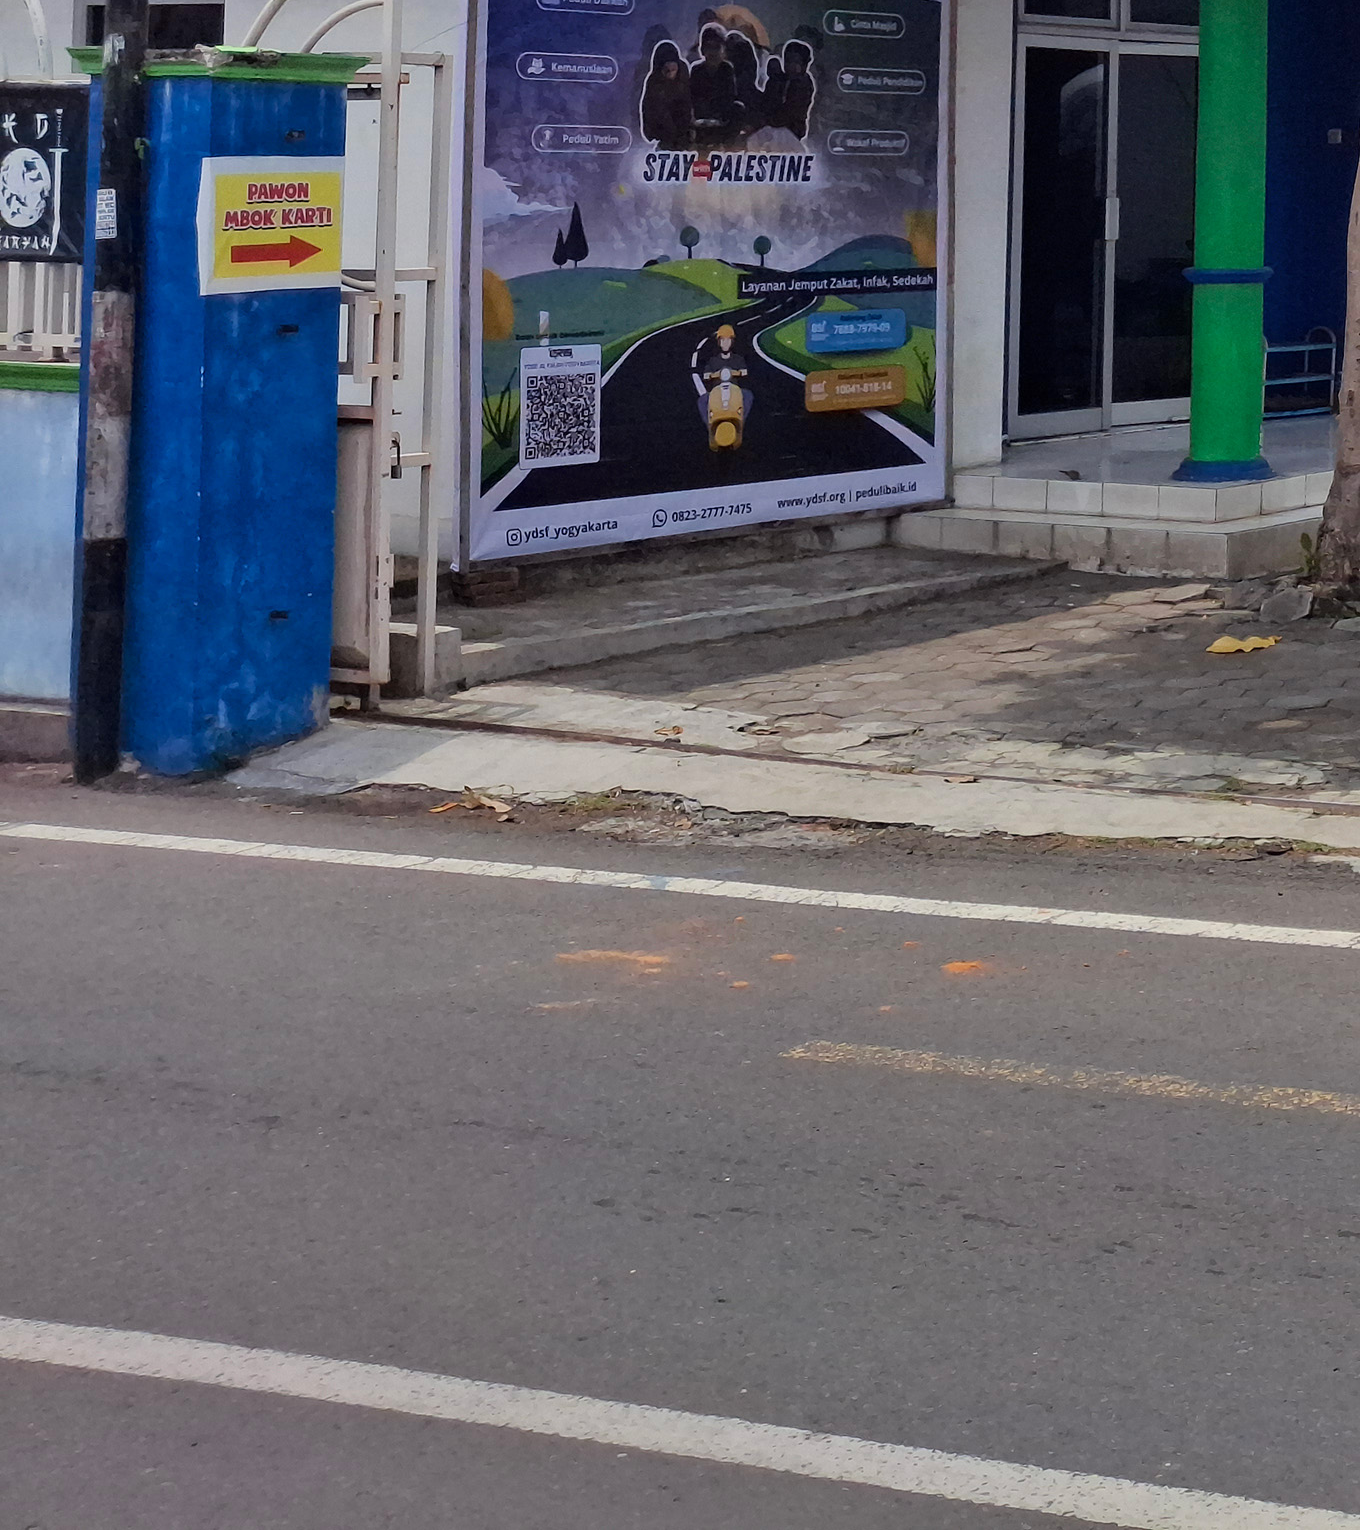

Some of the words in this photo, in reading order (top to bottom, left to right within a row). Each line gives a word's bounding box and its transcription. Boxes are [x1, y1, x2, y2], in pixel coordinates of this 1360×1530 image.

[643, 153, 696, 182] STAY
[707, 154, 814, 182] PALESTINE
[246, 181, 310, 204] PAWON
[222, 209, 278, 230] MBOK
[280, 206, 333, 229] KARTI
[742, 281, 786, 295] Layanan
[788, 278, 828, 292] Jemput
[830, 277, 861, 289] Zakat,
[863, 276, 891, 288] Infak,
[893, 274, 934, 285] Sedekah
[777, 491, 846, 509] www.ydsf.org
[855, 482, 917, 502] pedulibaik.id
[671, 502, 753, 523] 0823-2777-7475
[524, 520, 618, 543] ydsf_yogyakarta
